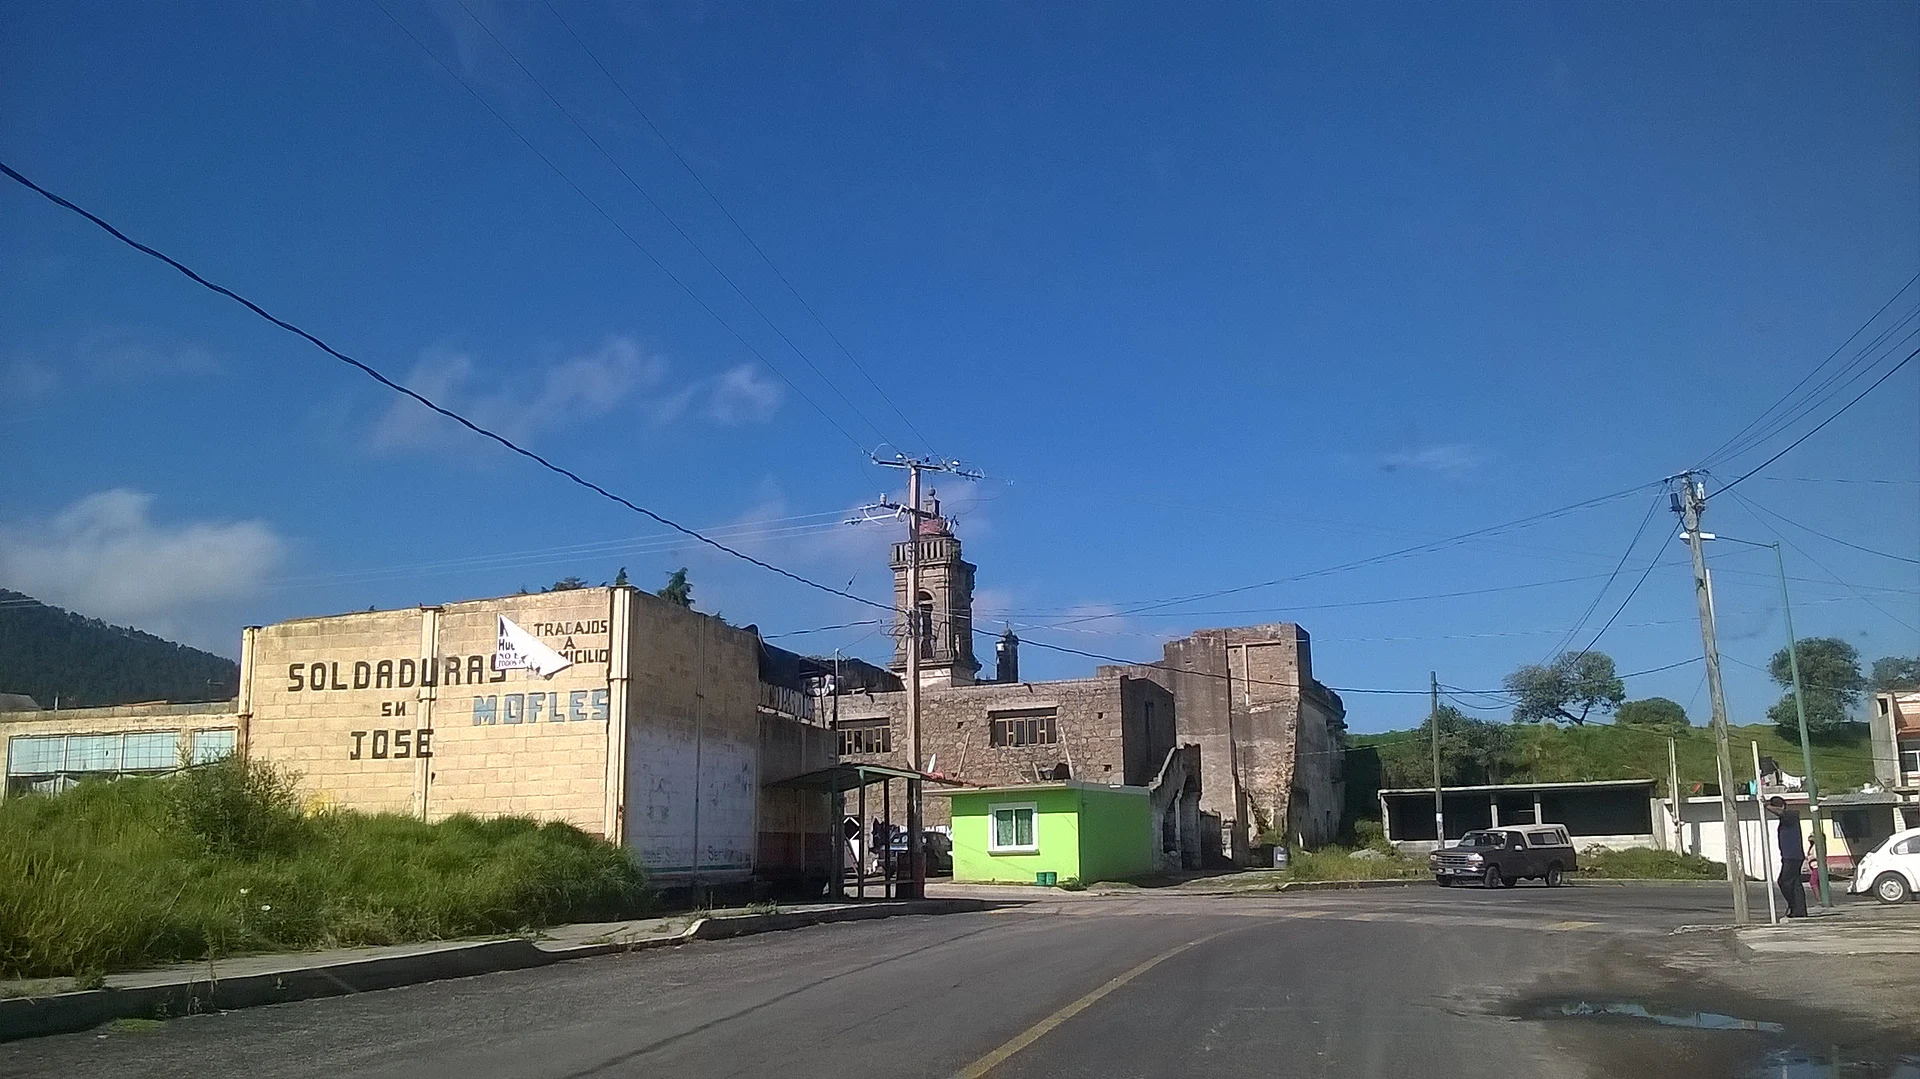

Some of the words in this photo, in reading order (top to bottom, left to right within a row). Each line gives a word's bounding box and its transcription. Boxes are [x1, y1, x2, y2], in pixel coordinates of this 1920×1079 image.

[558, 649, 609, 664] MICILIO
[564, 636, 576, 650] A
[288, 653, 507, 692] SOLDADURAS
[473, 688, 609, 726] MOFLES
[350, 729, 434, 760] JOSE
